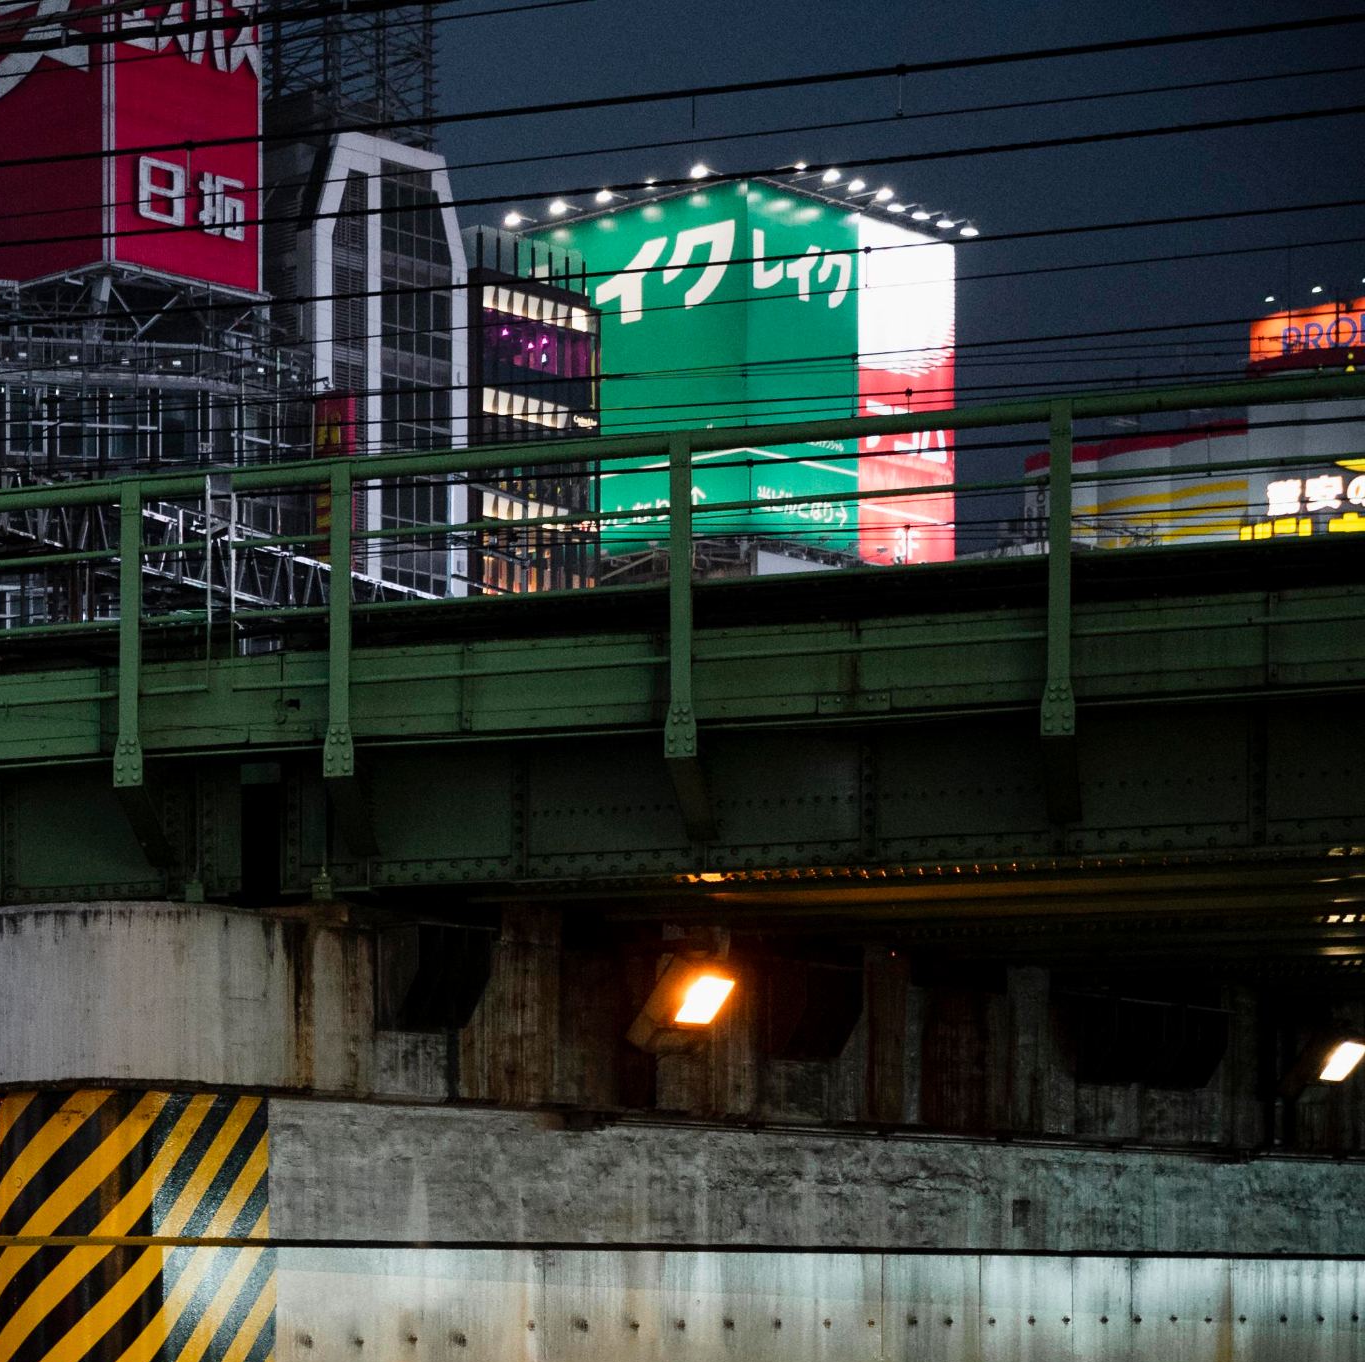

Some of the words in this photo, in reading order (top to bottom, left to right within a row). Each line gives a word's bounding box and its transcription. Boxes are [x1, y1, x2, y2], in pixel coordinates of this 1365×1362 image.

[531, 219, 736, 325] イク
[752, 228, 852, 310] レイク
[1282, 314, 1365, 354] PRO
[893, 528, 921, 558] 3F
